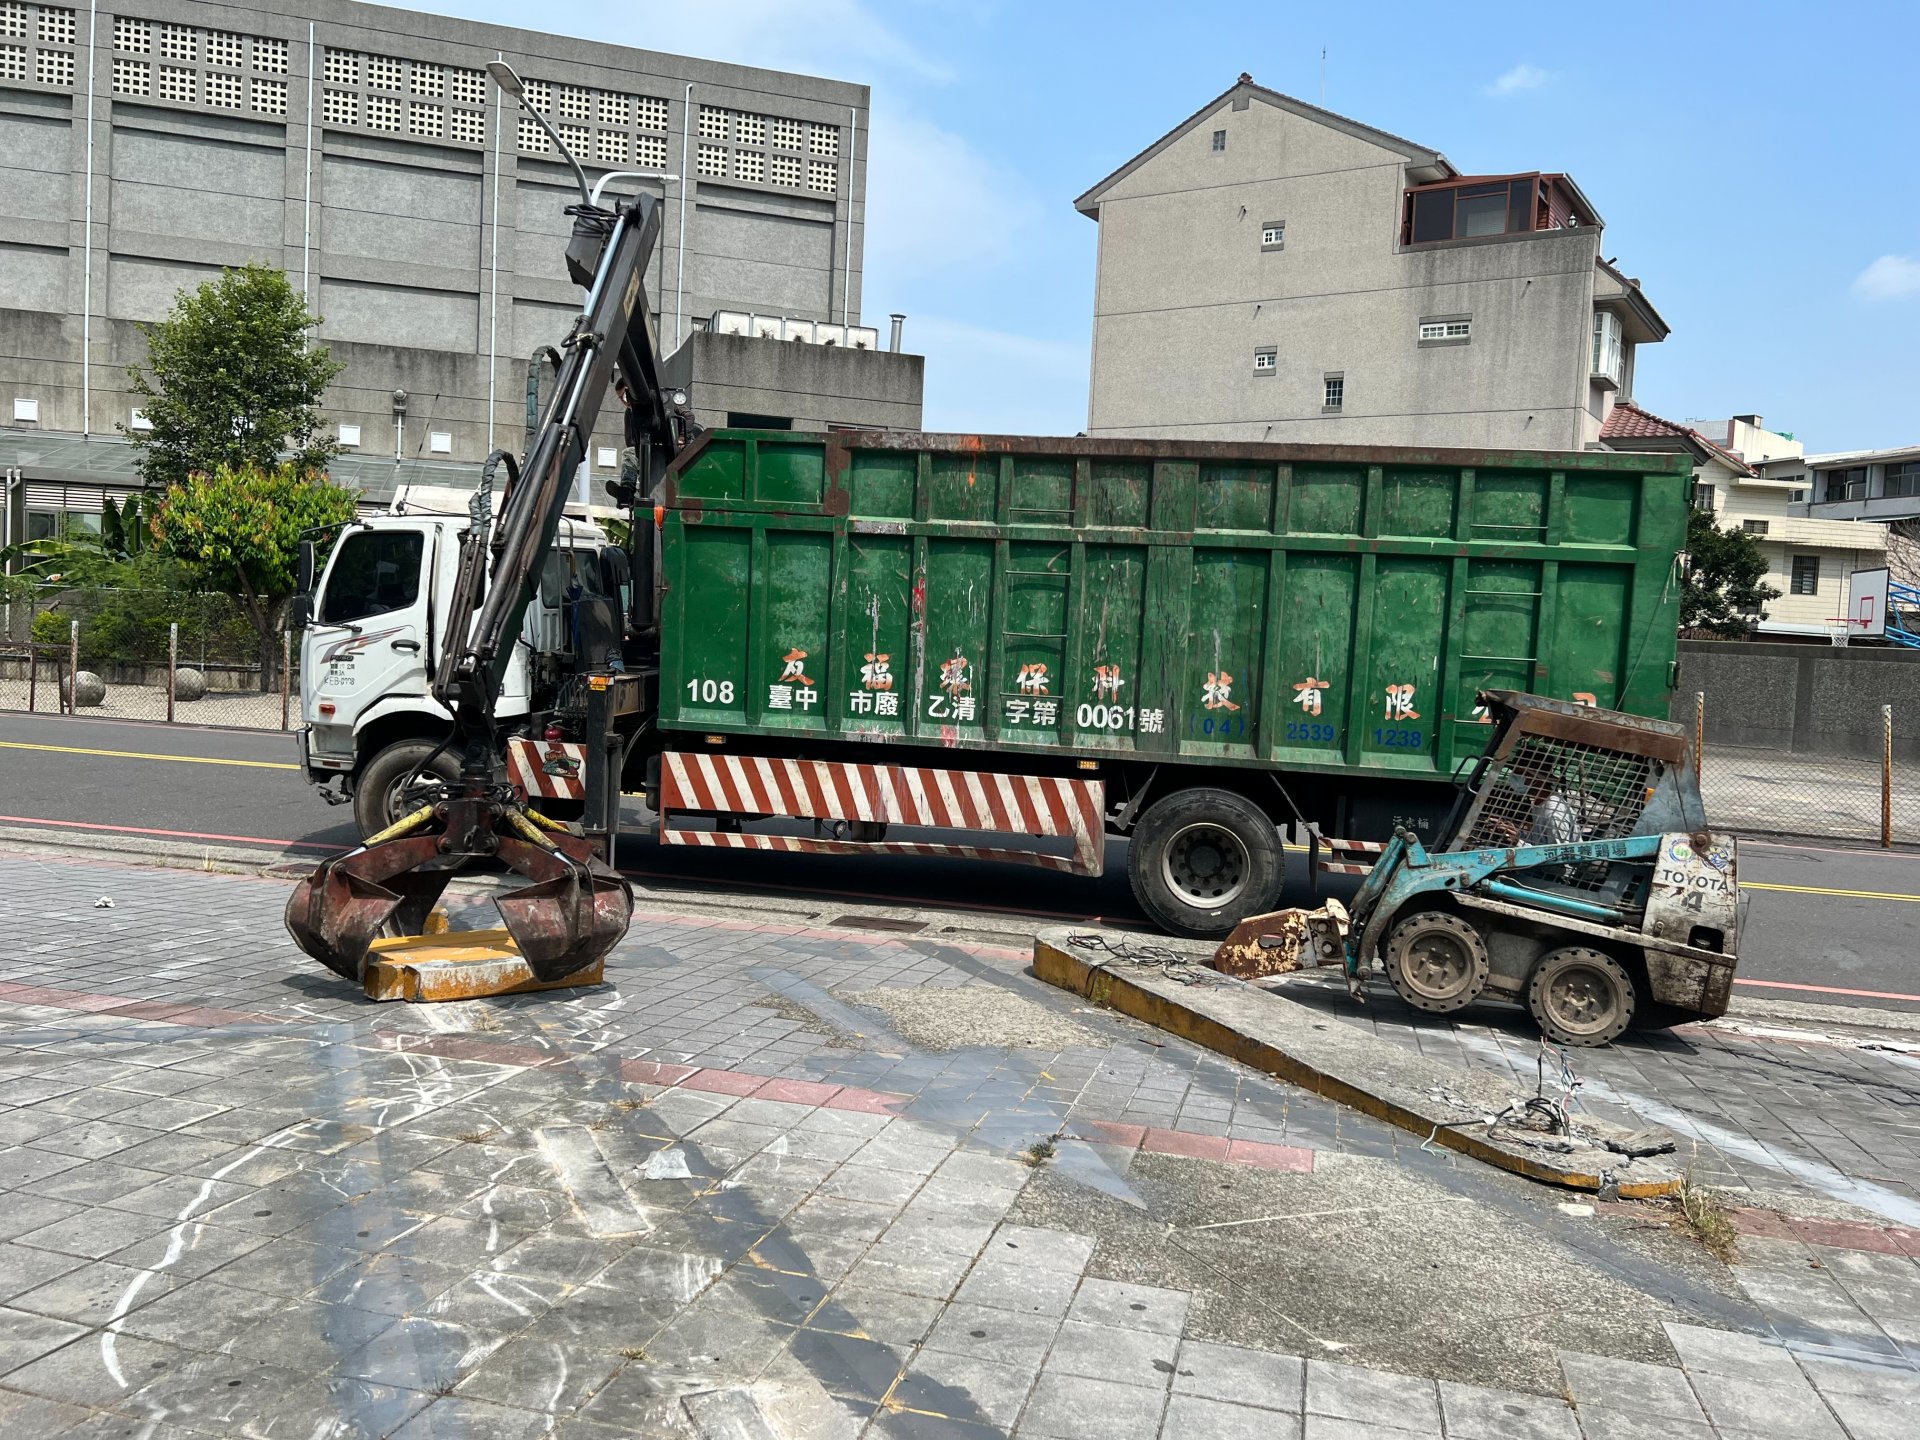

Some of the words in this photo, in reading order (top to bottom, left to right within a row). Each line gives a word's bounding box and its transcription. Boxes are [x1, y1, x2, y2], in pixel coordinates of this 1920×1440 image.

[687, 678, 735, 704] 108
[1189, 716, 1246, 738] (04)
[1286, 722, 1335, 742] 2539
[1374, 727, 1422, 748] 1238
[1662, 869, 1729, 892] TOYOTA
